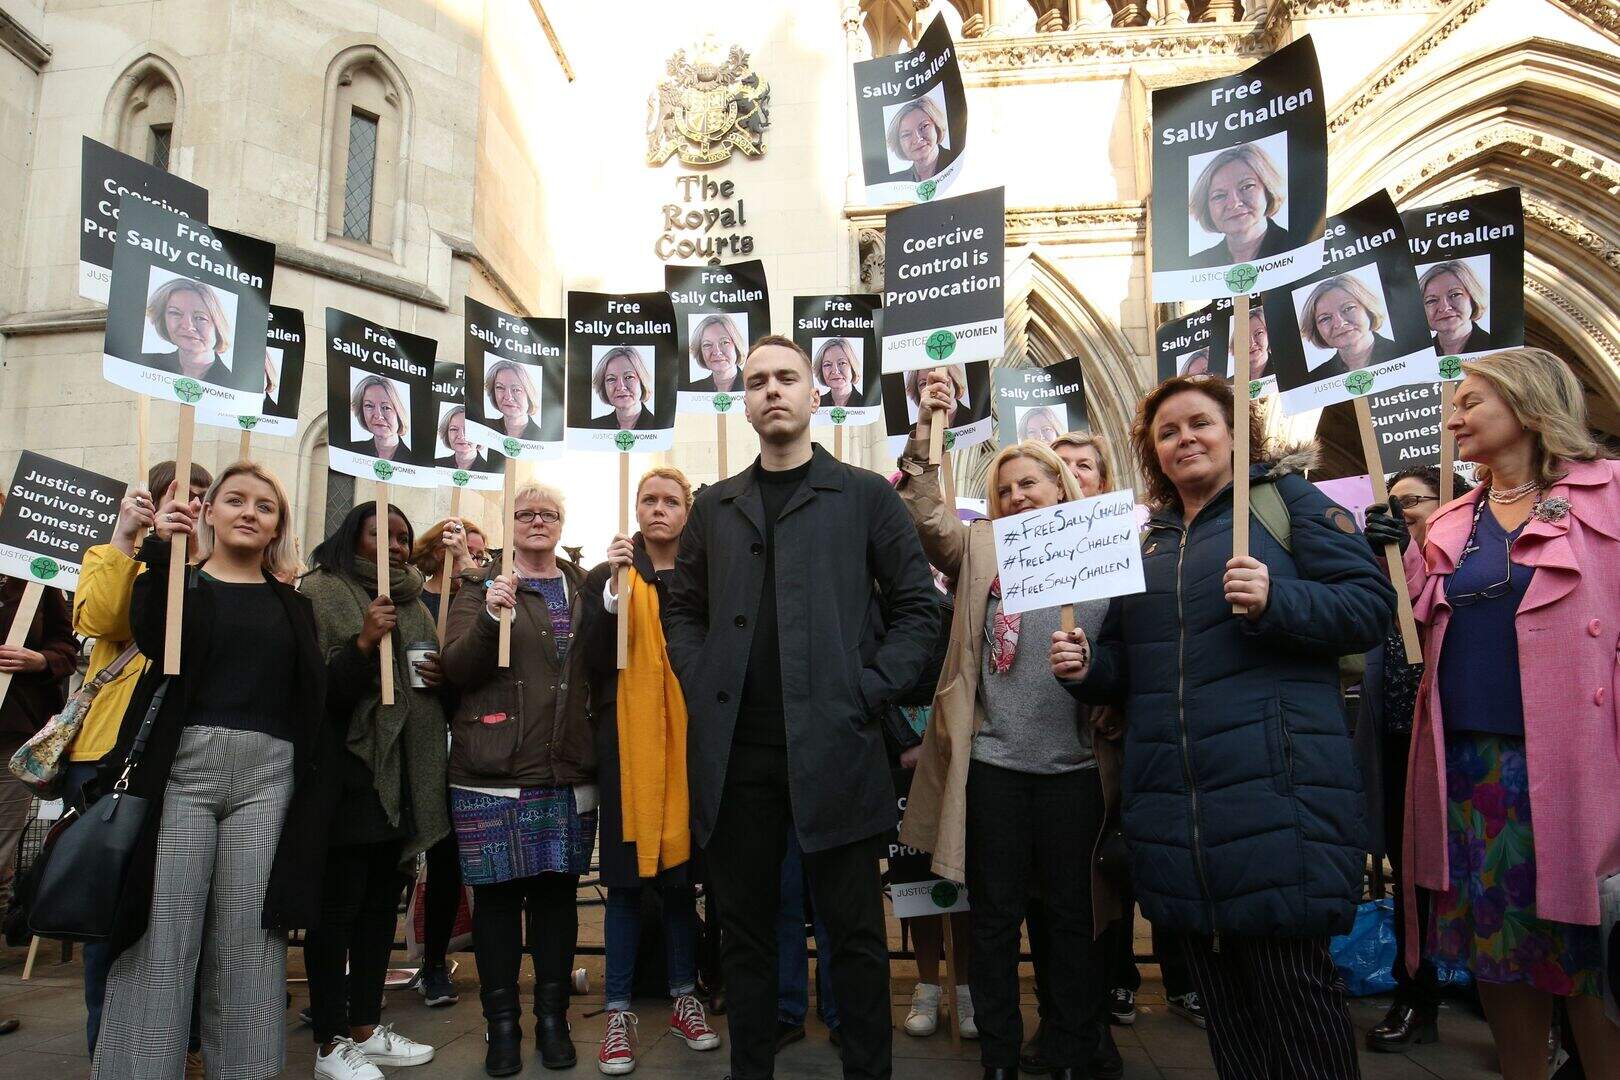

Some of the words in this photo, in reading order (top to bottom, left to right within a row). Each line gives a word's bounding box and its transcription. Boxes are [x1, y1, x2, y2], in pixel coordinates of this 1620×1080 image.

[862, 82, 902, 98] Sally
[905, 47, 950, 90] Challen
[895, 50, 927, 74] Free
[1211, 80, 1262, 107] Free
[1162, 120, 1218, 145] Sally
[1224, 87, 1313, 131] Challen
[676, 175, 735, 202] The
[662, 199, 747, 233] Royal
[1426, 208, 1470, 227] Free
[177, 222, 223, 251] Free
[903, 227, 984, 254] Coercive
[1324, 223, 1346, 241] ee
[1408, 238, 1432, 256] lly
[1437, 223, 1515, 248] Challen
[655, 233, 754, 260] Courts
[127, 229, 181, 262] Sally
[186, 251, 263, 289] Challen
[898, 252, 969, 279] Control
[973, 249, 989, 266] is
[1190, 271, 1228, 283] JUSTICE
[1232, 267, 1252, 277] FOR
[1256, 257, 1294, 273] WOMEN
[701, 272, 733, 285] Free
[671, 291, 707, 306] Sally
[709, 289, 763, 304] Challen
[886, 275, 1001, 307] Provocation
[608, 301, 640, 314] Free
[824, 301, 853, 312] Free
[1216, 298, 1235, 311] Sal
[498, 317, 529, 336] Free
[574, 320, 613, 337] Sally
[615, 321, 672, 335] Challen
[798, 319, 827, 331] Sally
[1186, 312, 1212, 328] Free
[266, 328, 300, 343] allen
[364, 327, 396, 349] Free
[470, 323, 501, 348] Sally
[505, 339, 560, 357] Challen
[888, 336, 927, 351] JUSTICE
[955, 326, 998, 340] WOMEN
[1162, 335, 1192, 351] Sally
[333, 337, 369, 362] Sally
[373, 351, 427, 377] Challen
[141, 370, 178, 385] JUSTICE
[202, 387, 235, 400] WOMEN
[1024, 373, 1052, 383] Free
[1314, 379, 1346, 394] JUSTICE
[1349, 373, 1369, 381] FOR
[1371, 361, 1406, 377] WOMEN
[1000, 388, 1029, 400] Sally
[1031, 383, 1079, 398] Challen
[1371, 386, 1429, 409] Justice
[954, 426, 976, 437] WOMEN
[1382, 422, 1442, 444] Domest
[1400, 443, 1441, 460] Abus
[393, 466, 416, 475] WOMEN
[1452, 463, 1475, 472] OMEN
[24, 470, 87, 497] Justice
[90, 489, 115, 506] for
[12, 484, 95, 519] Survivors
[98, 513, 117, 525] of
[18, 506, 99, 538] Domestic
[26, 529, 80, 552] Abuse
[0, 548, 35, 563] USTICE
[59, 563, 80, 575] WOM
[897, 886, 932, 898] JUSTICE
